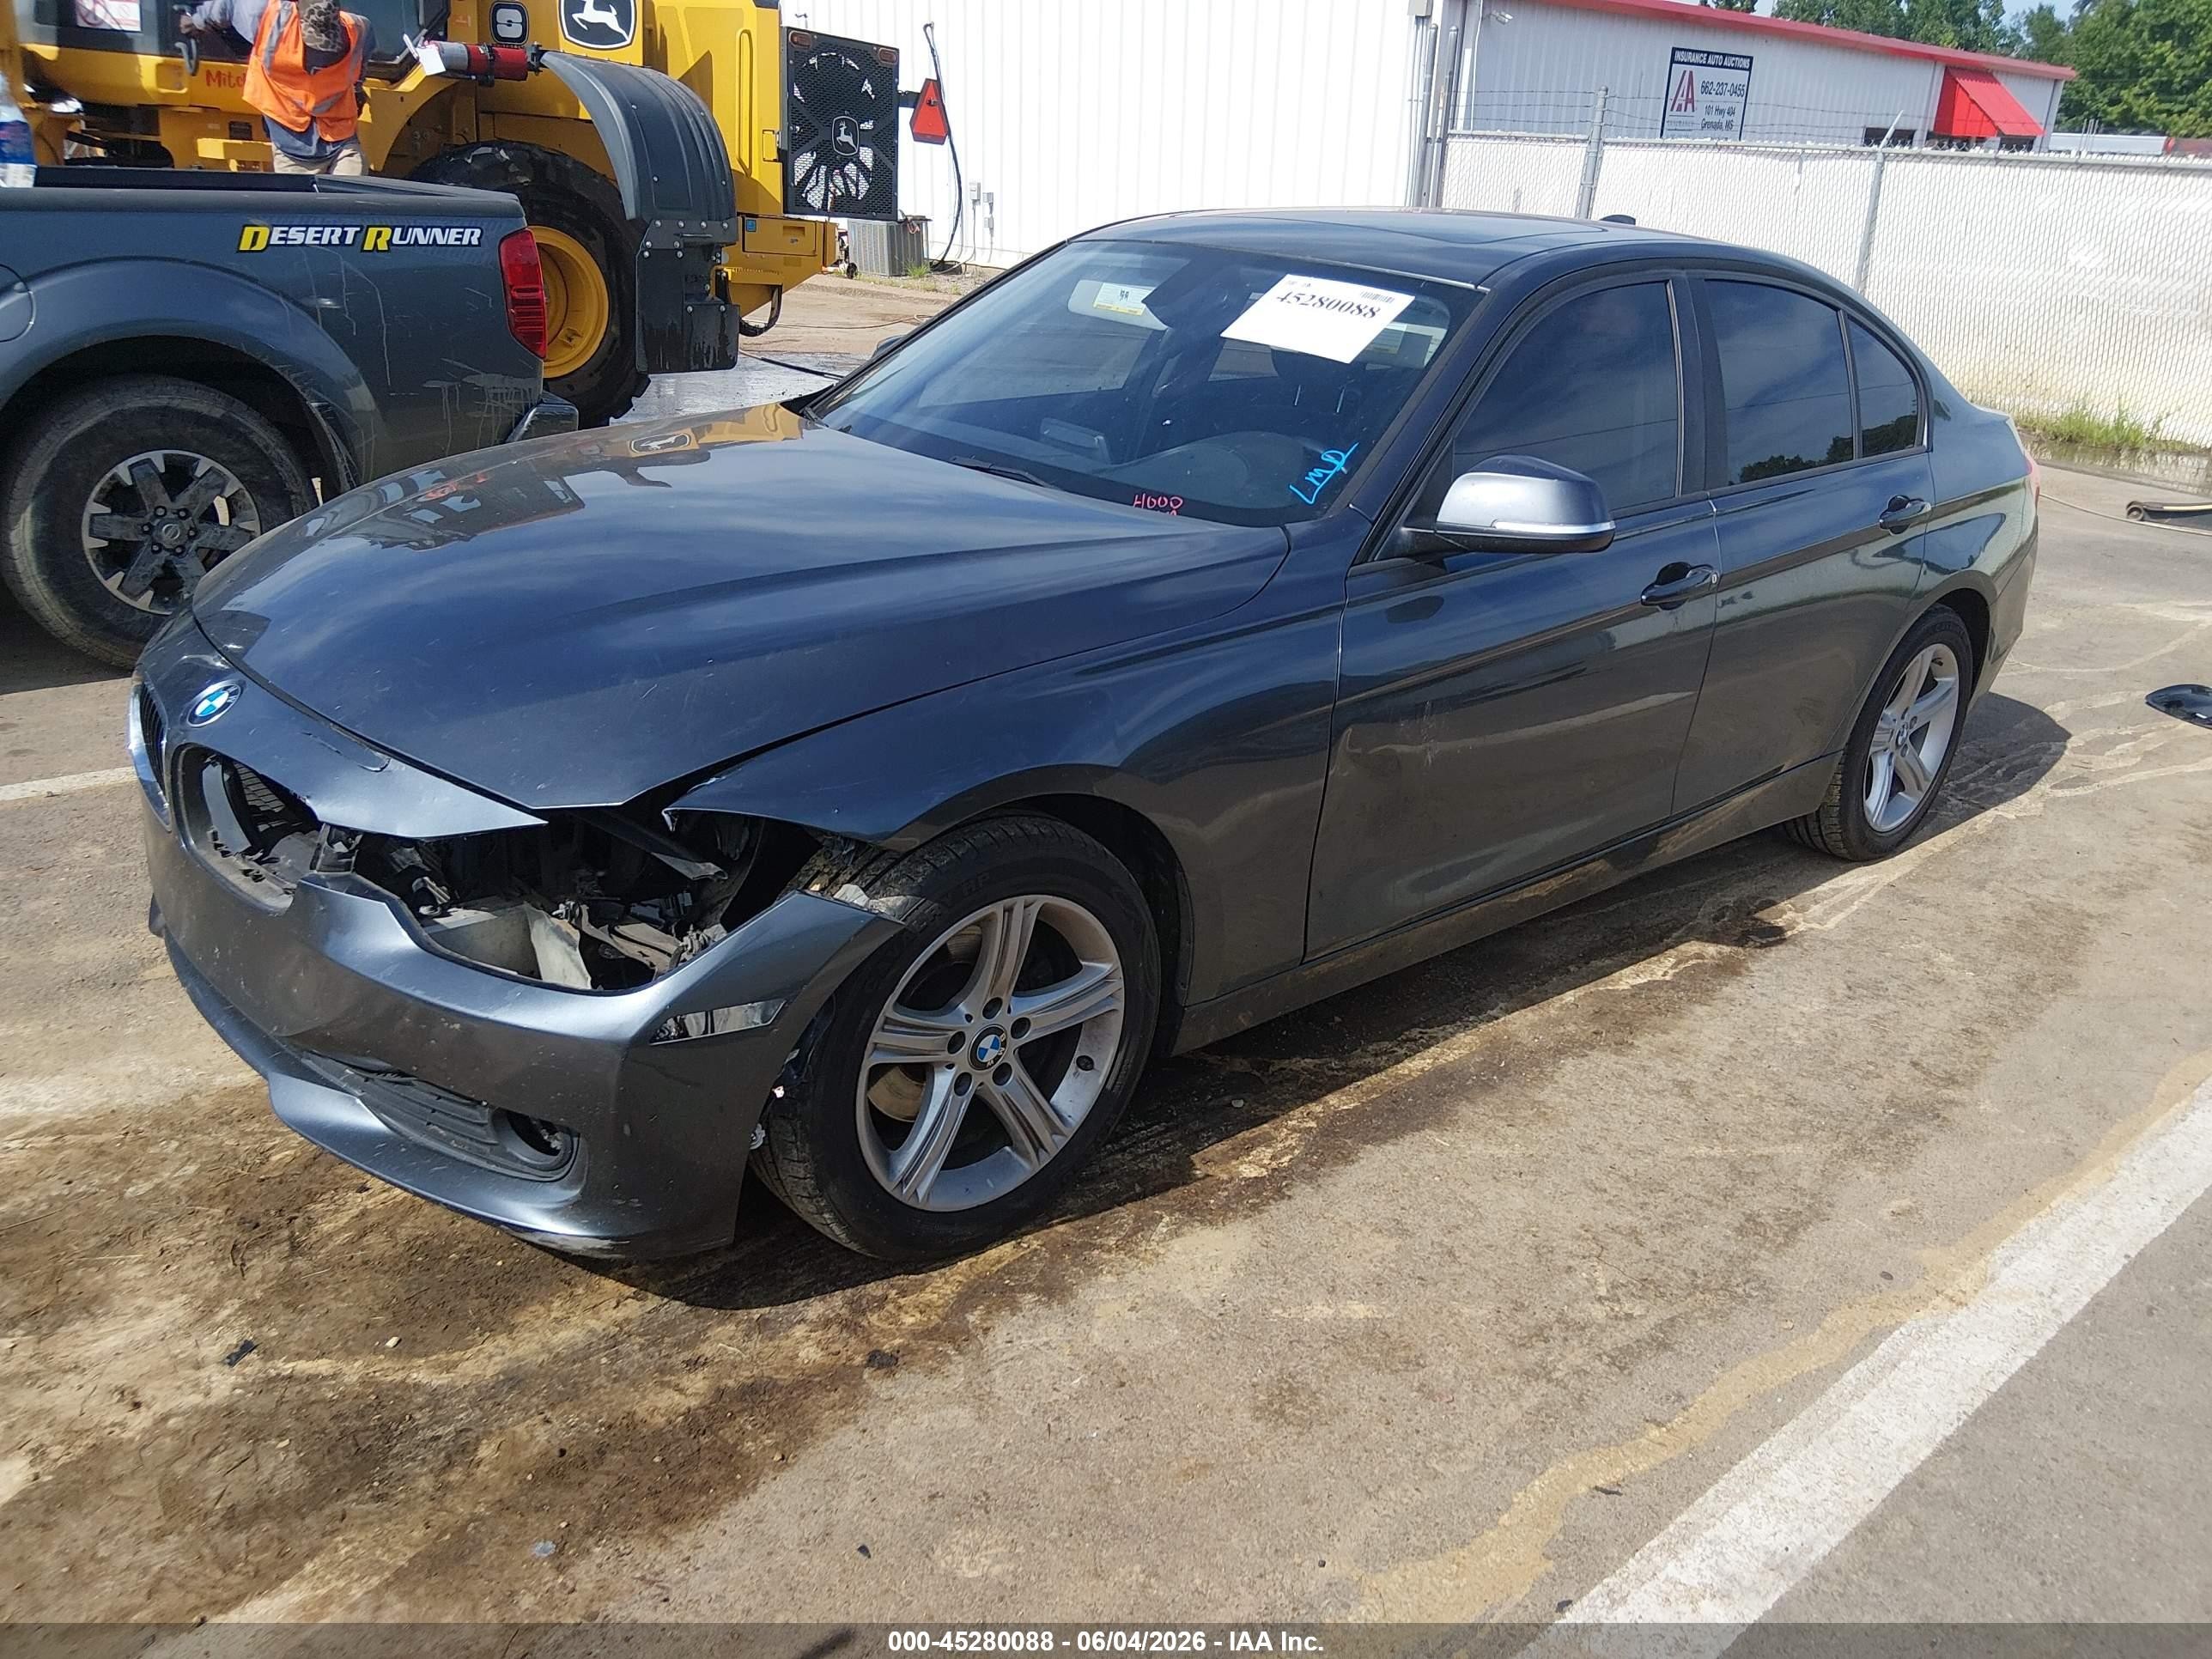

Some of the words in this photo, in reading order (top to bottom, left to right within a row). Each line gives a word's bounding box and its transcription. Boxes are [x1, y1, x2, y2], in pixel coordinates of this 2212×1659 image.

[1674, 50, 1707, 64] INSURANCE
[1707, 53, 1723, 66] AUTO
[1723, 56, 1751, 69] AUCTIONS
[1700, 80, 1746, 98] 662-237-0455
[1705, 105, 1714, 115] 101
[1714, 106, 1726, 118] Hwy
[1726, 106, 1736, 117] 404
[1700, 118, 1724, 131] Grenada,
[1724, 119, 1734, 131] MS
[237, 226, 362, 252] DESERT
[362, 227, 483, 252] RUNNER
[1276, 290, 1382, 319] 45280088
